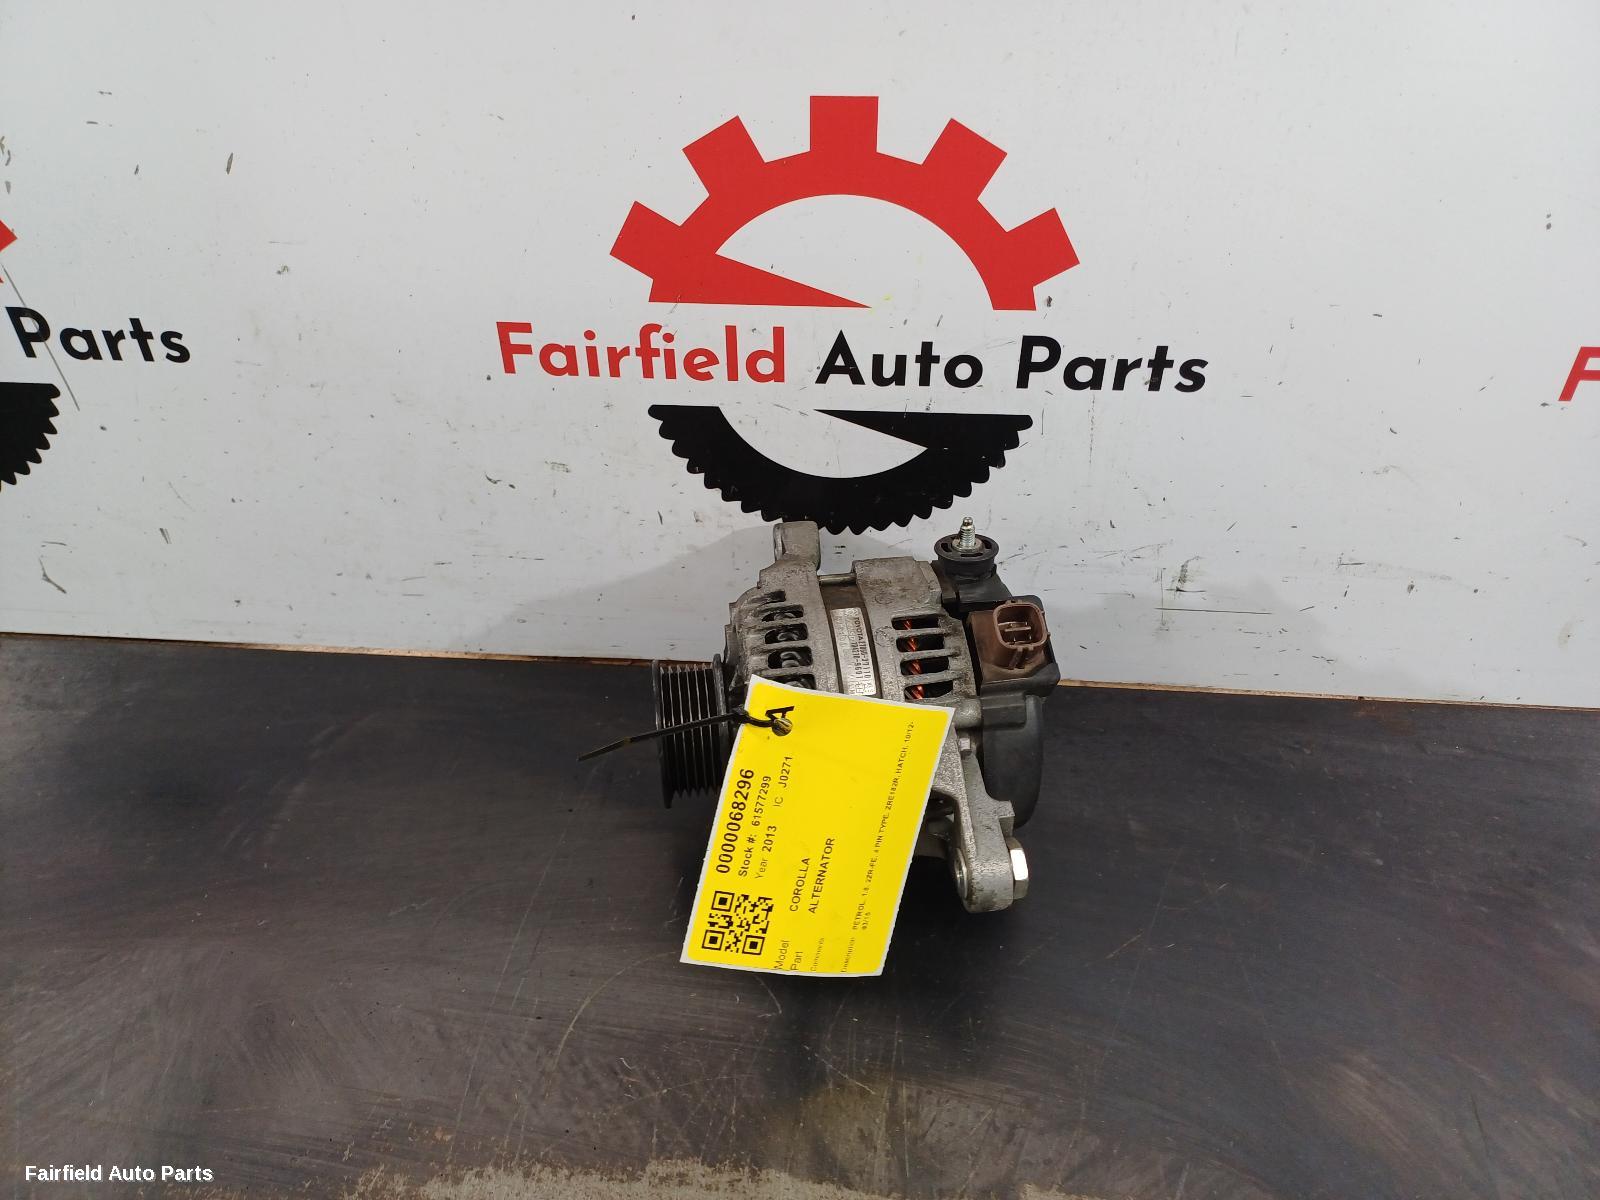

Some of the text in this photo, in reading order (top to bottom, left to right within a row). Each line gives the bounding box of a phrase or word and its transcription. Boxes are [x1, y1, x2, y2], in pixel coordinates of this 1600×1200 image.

[5, 306, 190, 363] Parts
[496, 321, 1209, 391] Fairfield Auto Parts
[716, 769, 754, 873] 0000068296
[738, 846, 753, 877] Stock
[751, 775, 771, 827] 61577299
[755, 756, 792, 879] Year 2013 IC J0271
[774, 858, 810, 970] Model COROLLA
[790, 838, 835, 971] Part ALTERNATOR
